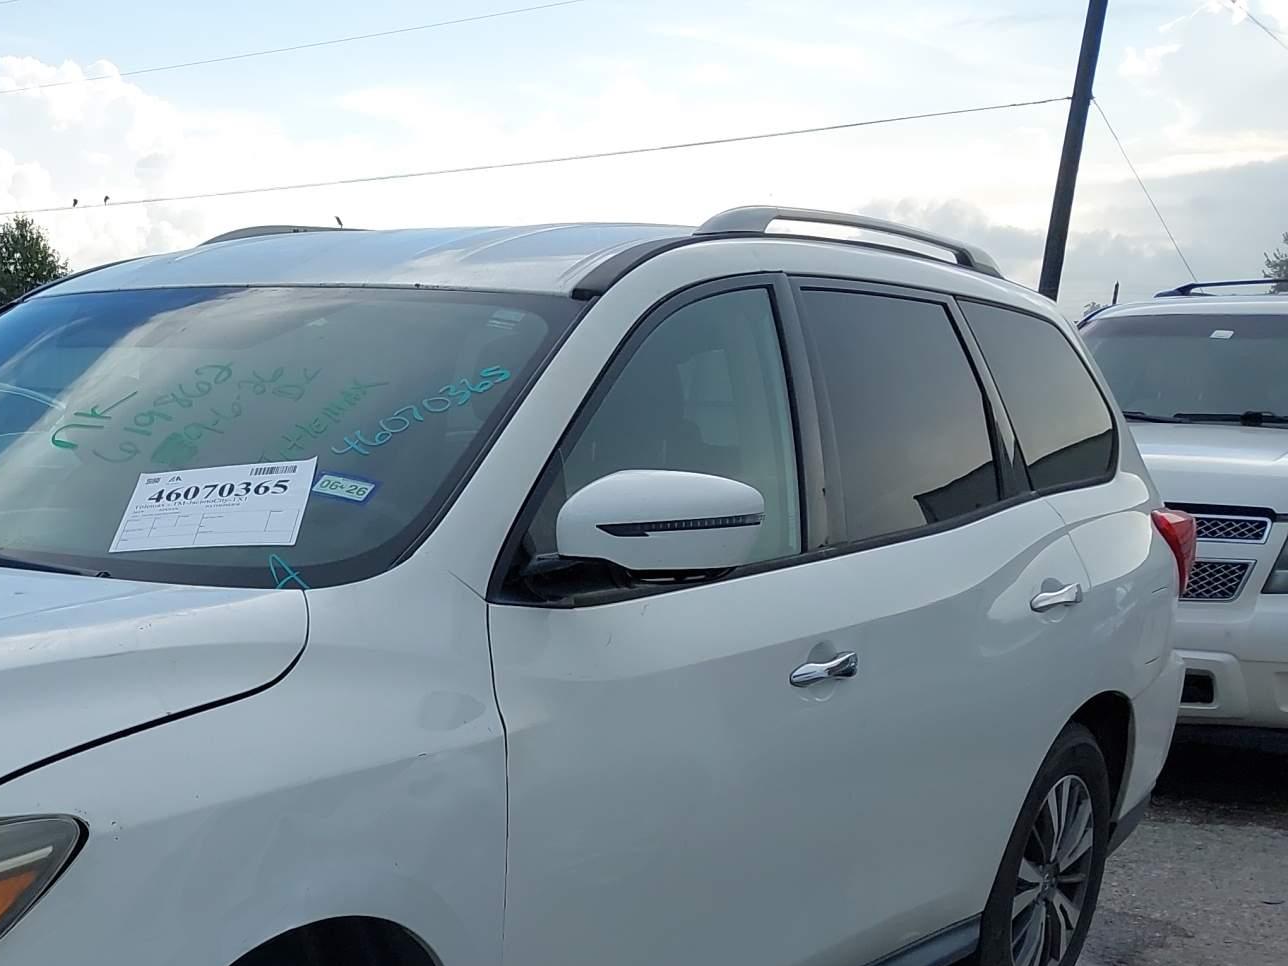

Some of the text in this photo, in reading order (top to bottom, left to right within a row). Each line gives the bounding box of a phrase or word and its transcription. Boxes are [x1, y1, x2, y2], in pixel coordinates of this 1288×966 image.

[331, 365, 511, 455] 46070365
[148, 479, 291, 503] 46070365
[269, 553, 311, 589] A
